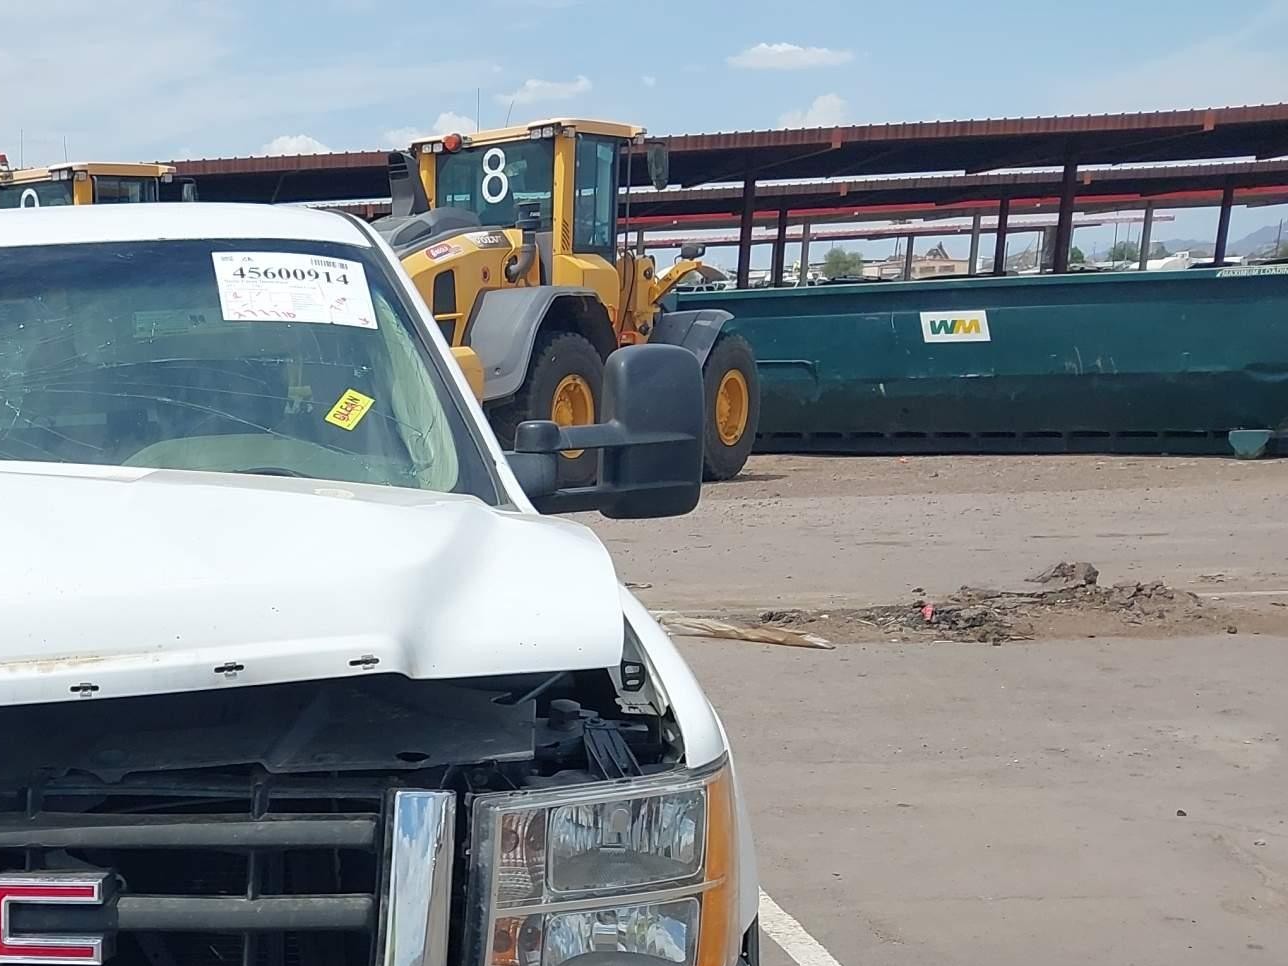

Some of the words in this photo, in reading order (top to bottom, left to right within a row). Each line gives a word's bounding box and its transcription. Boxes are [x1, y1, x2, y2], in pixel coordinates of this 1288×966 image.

[482, 147, 509, 204] 8
[232, 267, 349, 285] 45600914
[1222, 269, 1258, 277] MAXIMUM
[929, 319, 981, 335] WM
